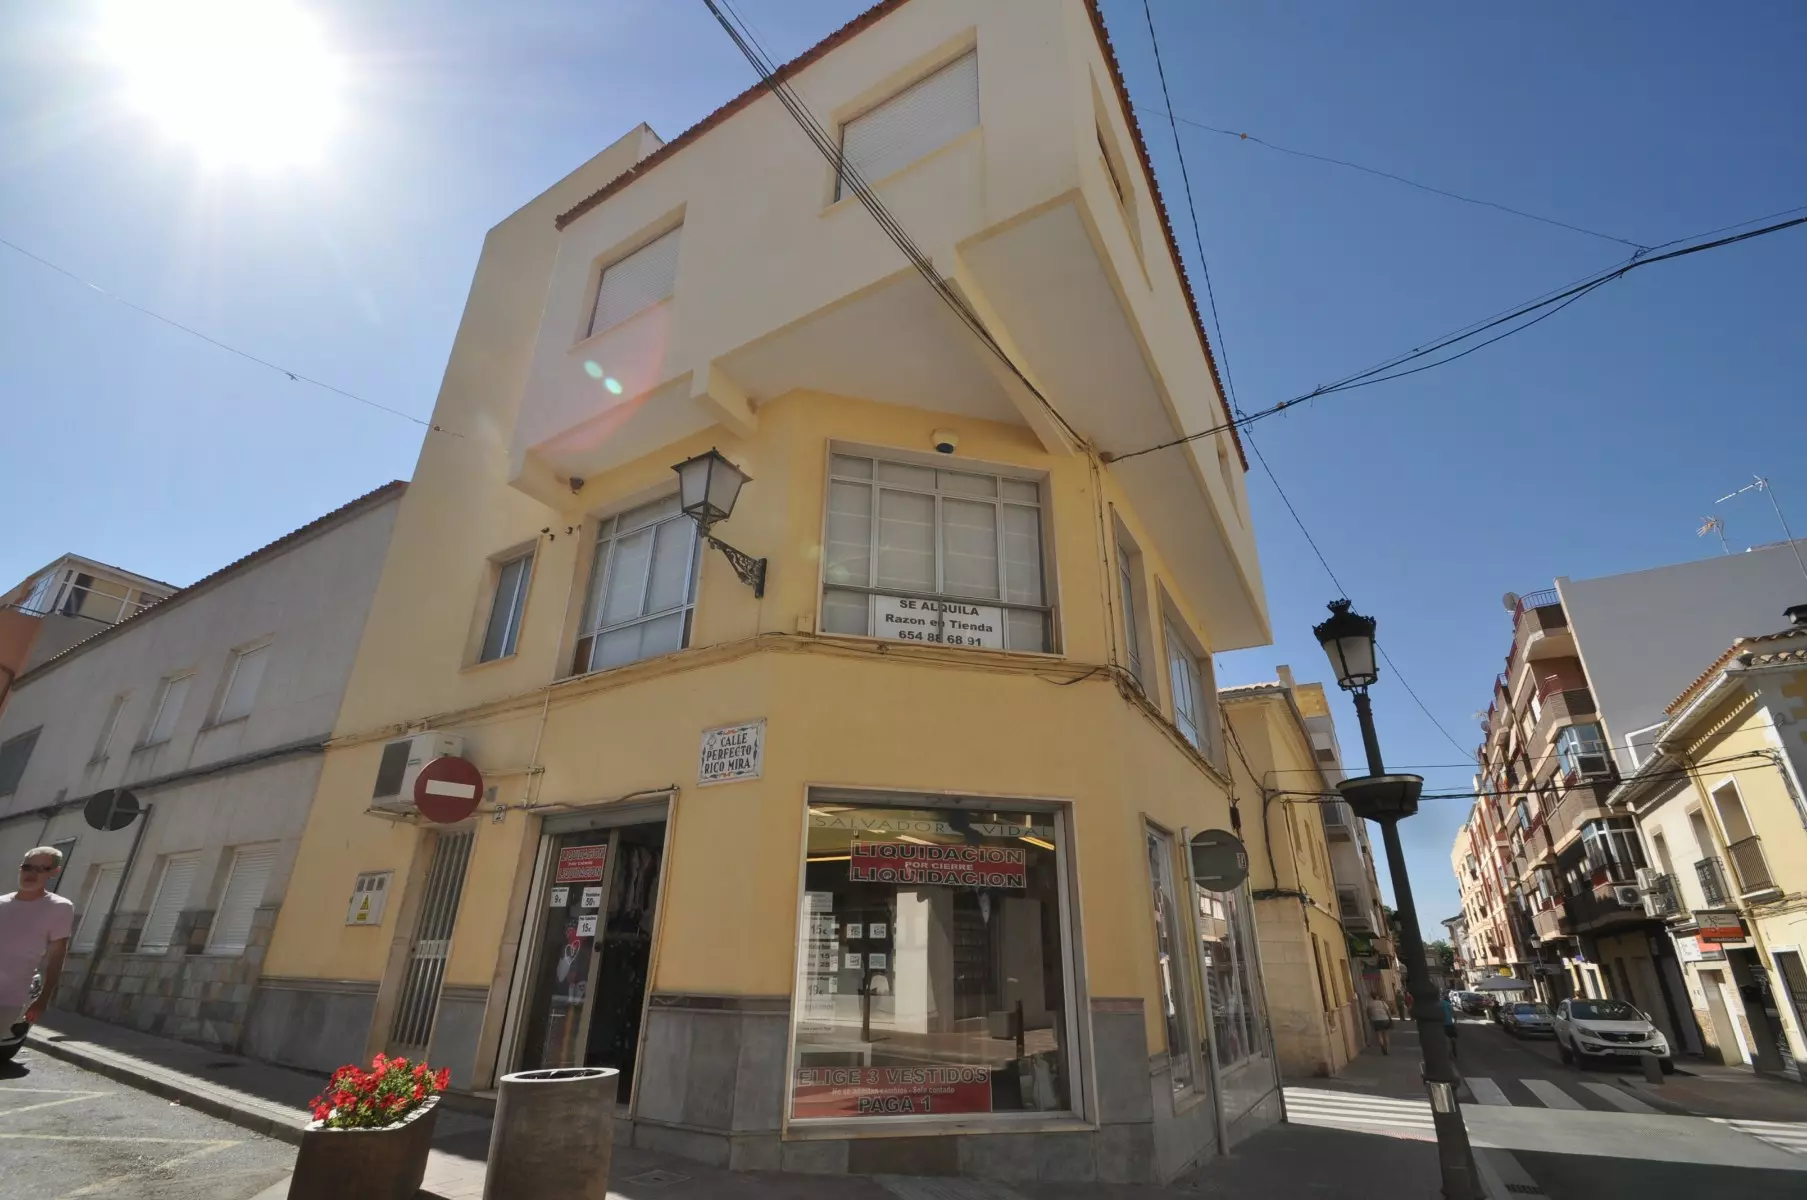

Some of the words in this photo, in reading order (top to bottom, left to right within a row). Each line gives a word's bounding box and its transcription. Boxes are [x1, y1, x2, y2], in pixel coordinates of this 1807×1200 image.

[900, 600, 917, 610] SE
[921, 602, 980, 616] ALQUILA
[885, 613, 926, 626] Razon
[950, 620, 993, 633] Tienda
[898, 630, 924, 641] 654
[947, 634, 963, 645] 68
[967, 636, 982, 647] 91
[720, 732, 748, 748] CALLE
[706, 744, 752, 762] PERFECTO
[704, 761, 725, 775] RICO
[727, 757, 750, 772] MIRA
[815, 816, 945, 833] SALVADOR
[982, 825, 1049, 837] VIDAL
[853, 842, 1024, 865] LIQUIDACION
[904, 861, 928, 869] POR
[931, 862, 974, 871] CIERRE
[852, 867, 1025, 888] LIQUIDACION
[797, 1068, 861, 1087] ELIGE
[866, 1068, 880, 1084] 3
[885, 1067, 989, 1084] VESTIDOS
[857, 1095, 915, 1113] PAGA
[920, 1094, 931, 1112] 1
